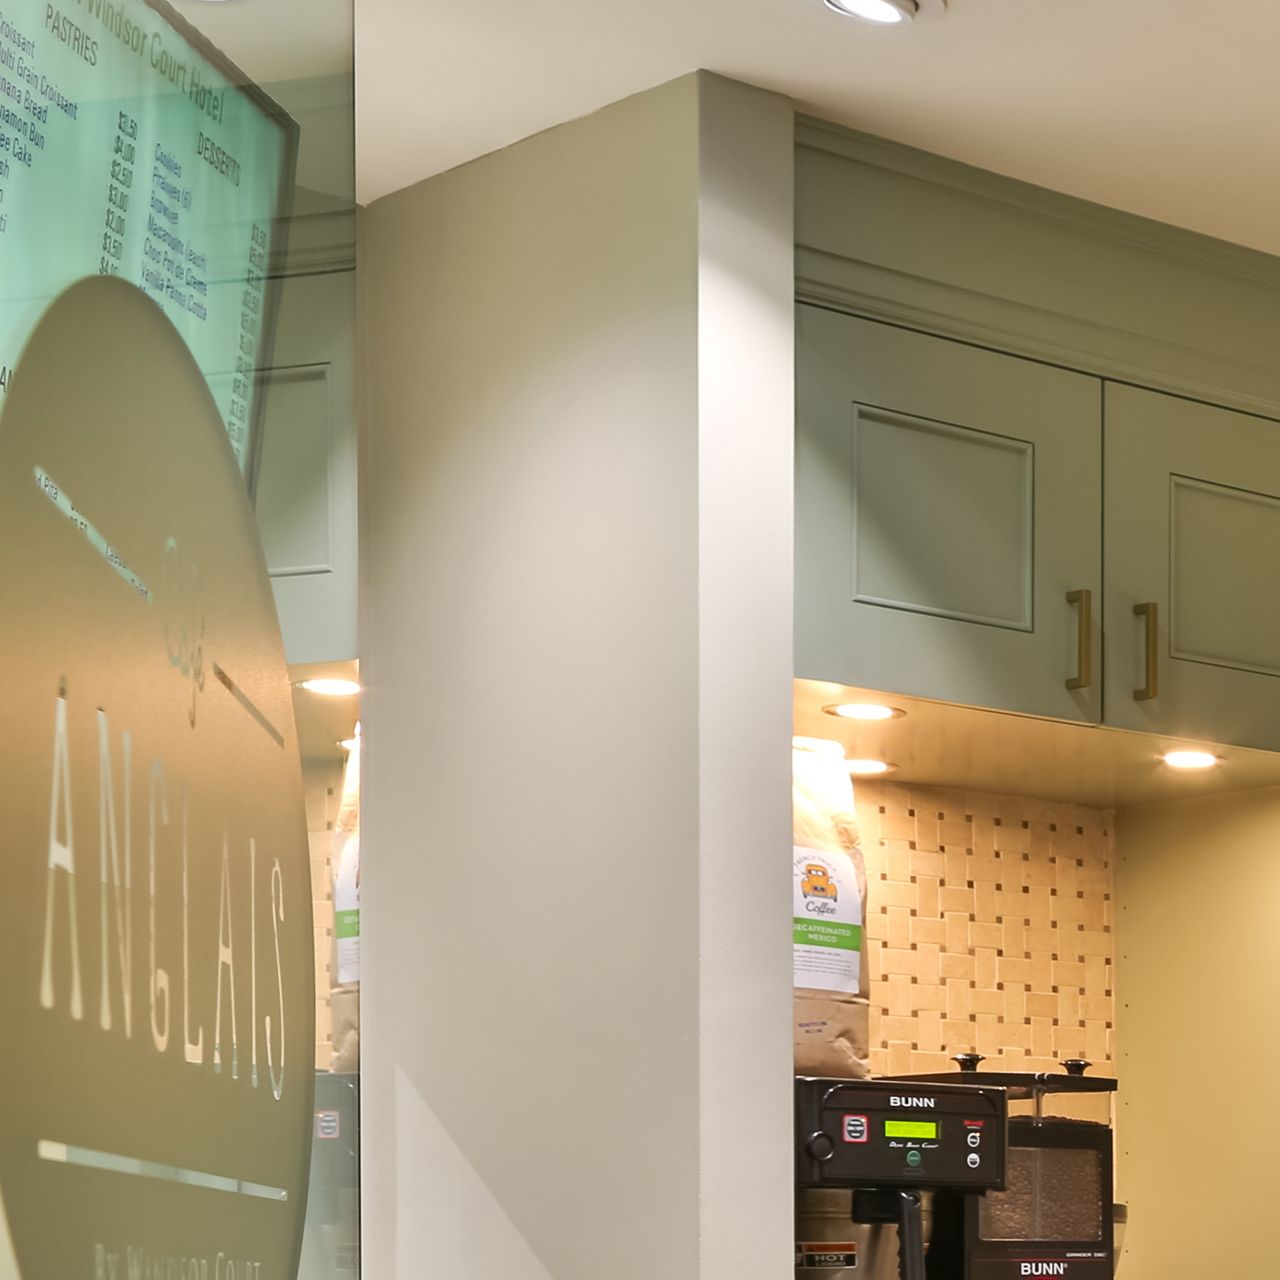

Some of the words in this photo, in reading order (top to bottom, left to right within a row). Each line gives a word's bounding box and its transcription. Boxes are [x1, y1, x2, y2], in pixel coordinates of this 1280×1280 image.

[45, 2, 98, 66] PASTRIES
[0, 76, 21, 104] nana
[24, 89, 48, 124] Bread
[17, 56, 38, 90] Grain
[40, 75, 78, 121] Croissant
[150, 32, 187, 94] Court
[190, 66, 225, 125] Hotel
[0, 104, 28, 137] namon
[29, 122, 45, 150] Bun
[12, 137, 32, 168] Cake
[197, 131, 241, 187] DESSERTS
[39, 674, 286, 1101] ANGLAIS
[805, 900, 837, 917] Coffee
[889, 1096, 936, 1108] BUNN
[815, 1254, 845, 1262] HOT
